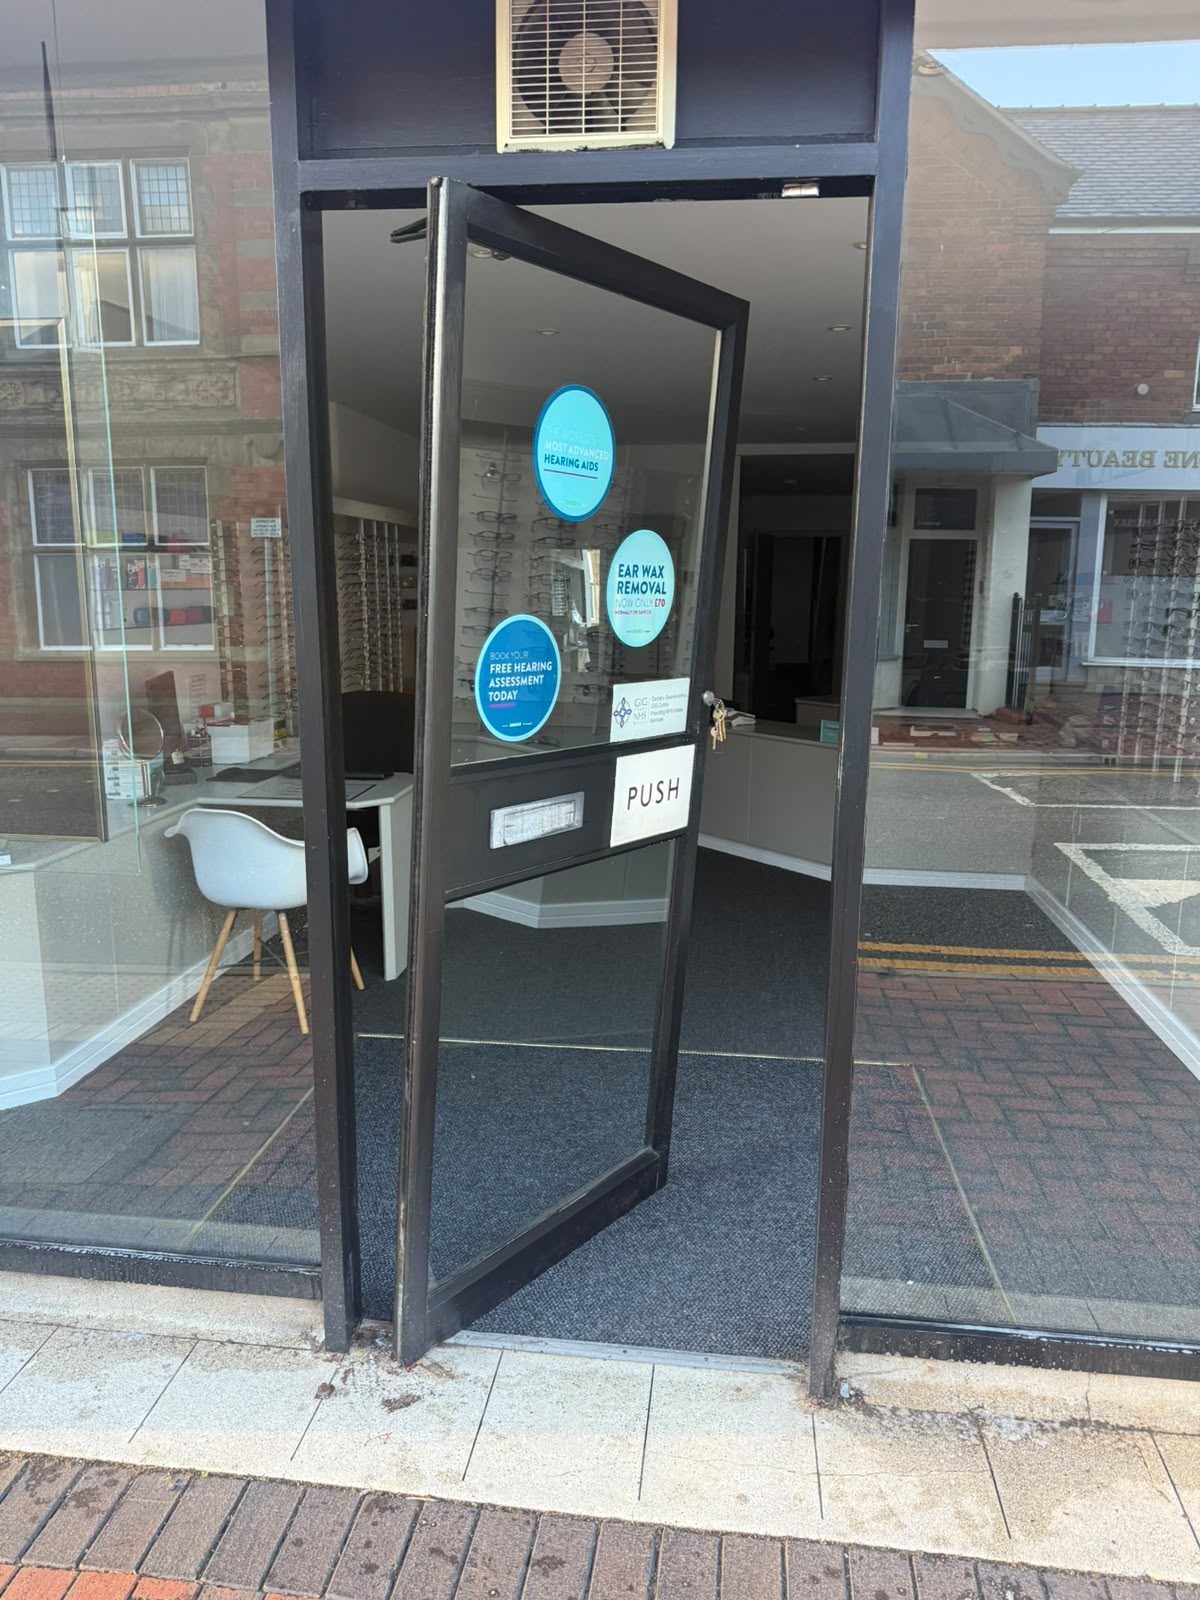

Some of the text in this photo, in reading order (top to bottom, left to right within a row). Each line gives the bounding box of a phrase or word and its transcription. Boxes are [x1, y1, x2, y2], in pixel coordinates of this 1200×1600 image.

[544, 440, 609, 461] MOST ADVANCED
[543, 453, 599, 472] HEARING AIDS
[618, 564, 665, 579] EAR WAX
[617, 580, 667, 595] REMOVAL
[615, 598, 666, 608] NOW ONLY £70
[490, 651, 529, 660] BOOK YOUR
[489, 661, 553, 674] FREE HEARING
[488, 675, 545, 688] ASSESSMENT
[488, 690, 518, 702] TODAY
[633, 711, 647, 721] NHS
[627, 776, 680, 811] PUSH
